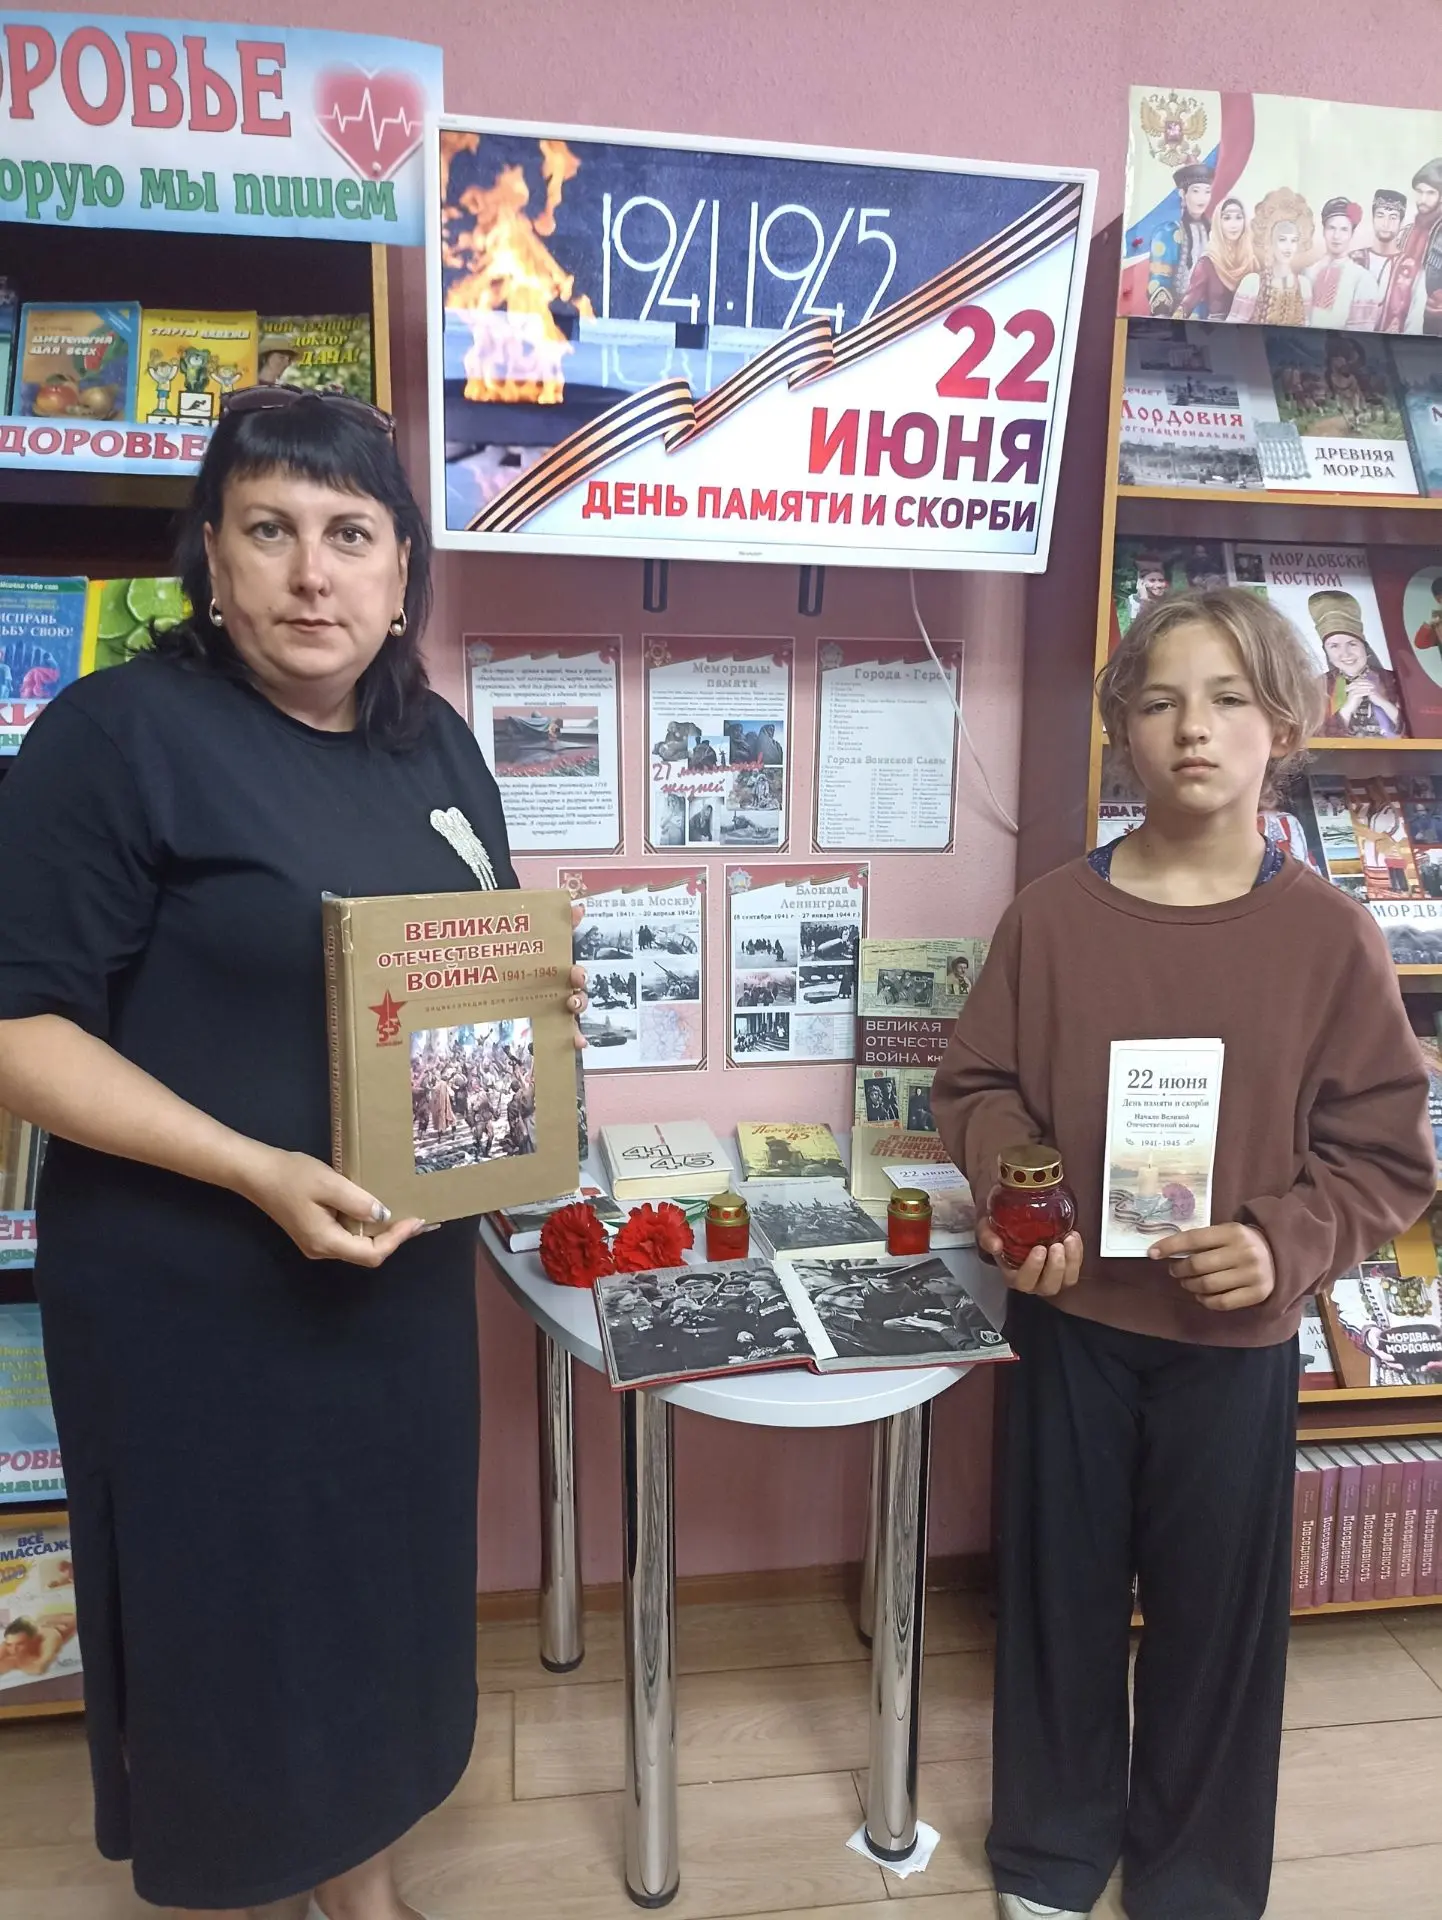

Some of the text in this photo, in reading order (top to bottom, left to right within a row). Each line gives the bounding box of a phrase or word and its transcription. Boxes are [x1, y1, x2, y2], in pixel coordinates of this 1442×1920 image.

[0, 23, 292, 137] РОВЬЕ
[140, 167, 218, 213] мы
[234, 173, 398, 222] пишем
[299, 349, 361, 368] ДАЧА!
[935, 305, 1056, 404] 22
[1120, 424, 1246, 442] огонациональная
[808, 406, 1048, 485] ИЮНЯ
[1315, 447, 1396, 463] ДРЕВНЯЯ
[1323, 463, 1397, 479] МОРДВА
[582, 480, 1037, 533] ДЕНЬ ПАМЯТИ И СКОРБИ
[1271, 570, 1343, 588] КОСТЮМ
[30, 627, 74, 638] СВОЮ!
[692, 662, 771, 677] Мемориалы
[854, 668, 902, 681] Города
[706, 677, 759, 689] памяти
[827, 755, 862, 766] Города
[652, 762, 672, 782] 27
[796, 886, 849, 896] Блокада
[586, 895, 698, 908] Битва за Москву
[780, 899, 857, 910] Ленинграда
[1372, 904, 1442, 919] МОРДВ
[404, 914, 531, 943] ВЕЛИКАЯ
[377, 940, 545, 969] ОТЕЧЕСТВЕННАЯ
[406, 964, 500, 993] ВОЙНА
[866, 1020, 942, 1033] ВЕЛИКАЯ
[865, 1050, 921, 1064] ВОЙНА
[1127, 1069, 1208, 1090] 22 июня
[1121, 1099, 1142, 1107] День
[1144, 1100, 1173, 1108] памяти
[1181, 1099, 1210, 1109] скорби
[1126, 1121, 1200, 1129] Отечественной войны
[1134, 1113, 1190, 1121] Начало Великой
[622, 1144, 673, 1159] 41
[650, 1152, 715, 1170] 45
[900, 1170, 920, 1178] 22
[1385, 1331, 1430, 1343] МОРДВА
[1385, 1341, 1442, 1355] МОРДОВИЯ
[17, 1531, 44, 1547] ВСЁ
[1380, 1512, 1397, 1580] Повседневность
[1400, 1509, 1417, 1577] Повседневность
[1421, 1509, 1438, 1577] Повседневность
[1299, 1520, 1315, 1589] Повседневность
[1319, 1515, 1333, 1587] Повседневность
[1339, 1515, 1355, 1584] Повседневность
[1360, 1514, 1376, 1582] Повседневность
